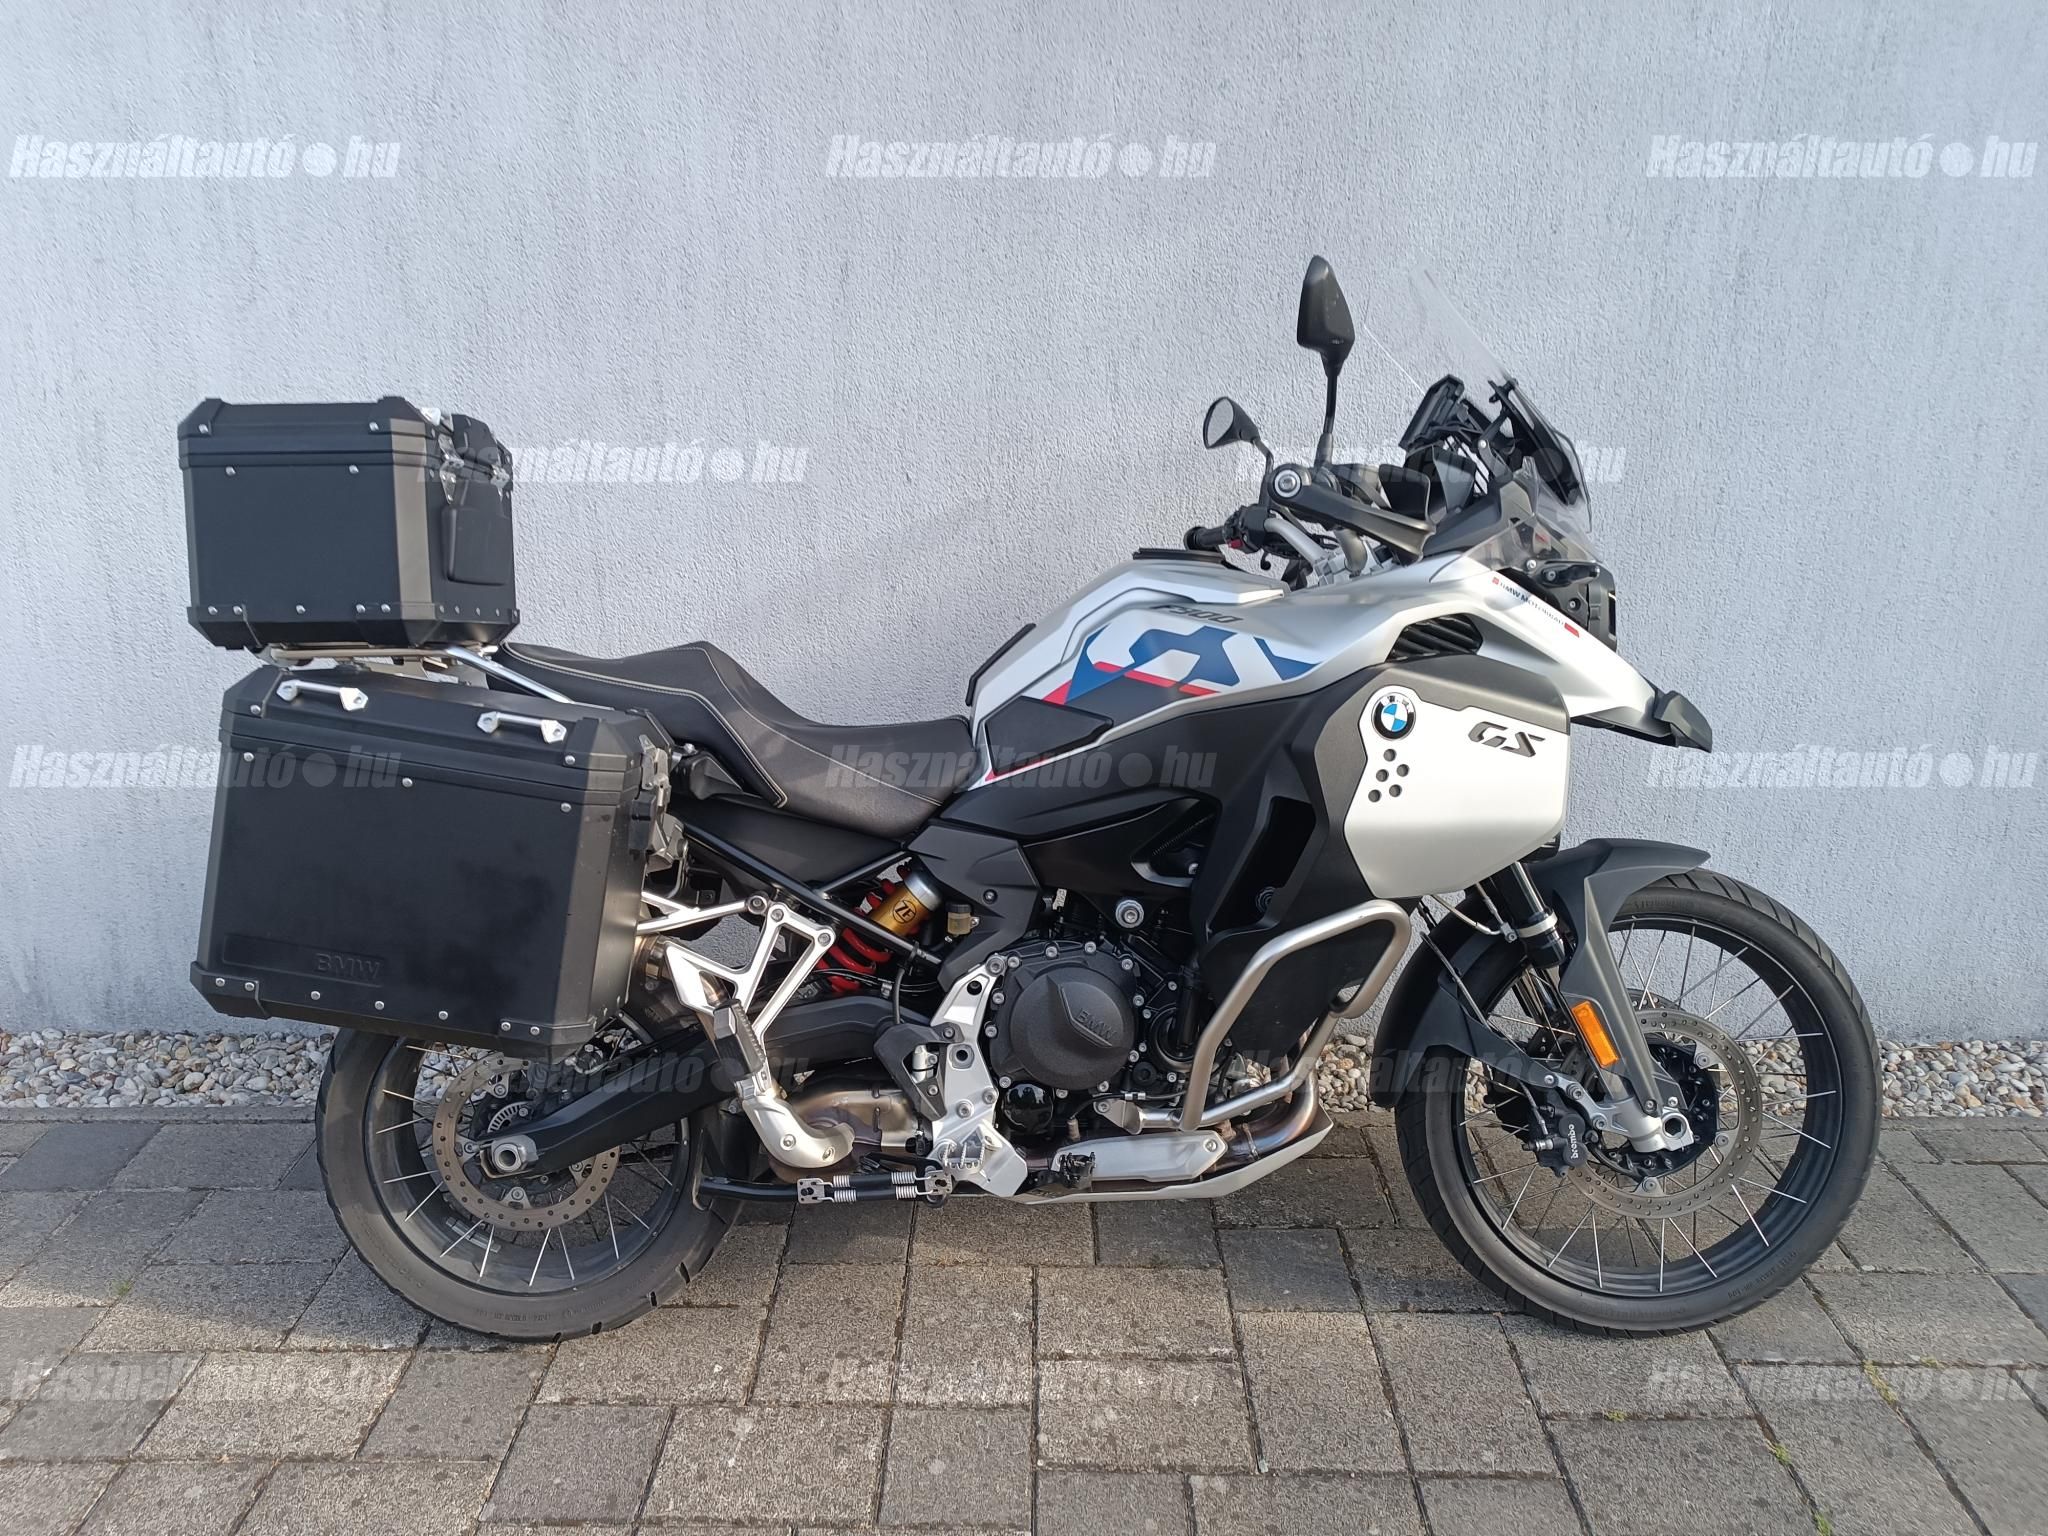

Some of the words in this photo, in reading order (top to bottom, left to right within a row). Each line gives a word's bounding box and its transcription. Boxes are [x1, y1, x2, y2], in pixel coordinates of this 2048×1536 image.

[1467, 720, 1546, 758] GS
[314, 952, 381, 979] BMW
[1568, 1123, 1579, 1159] brembo
